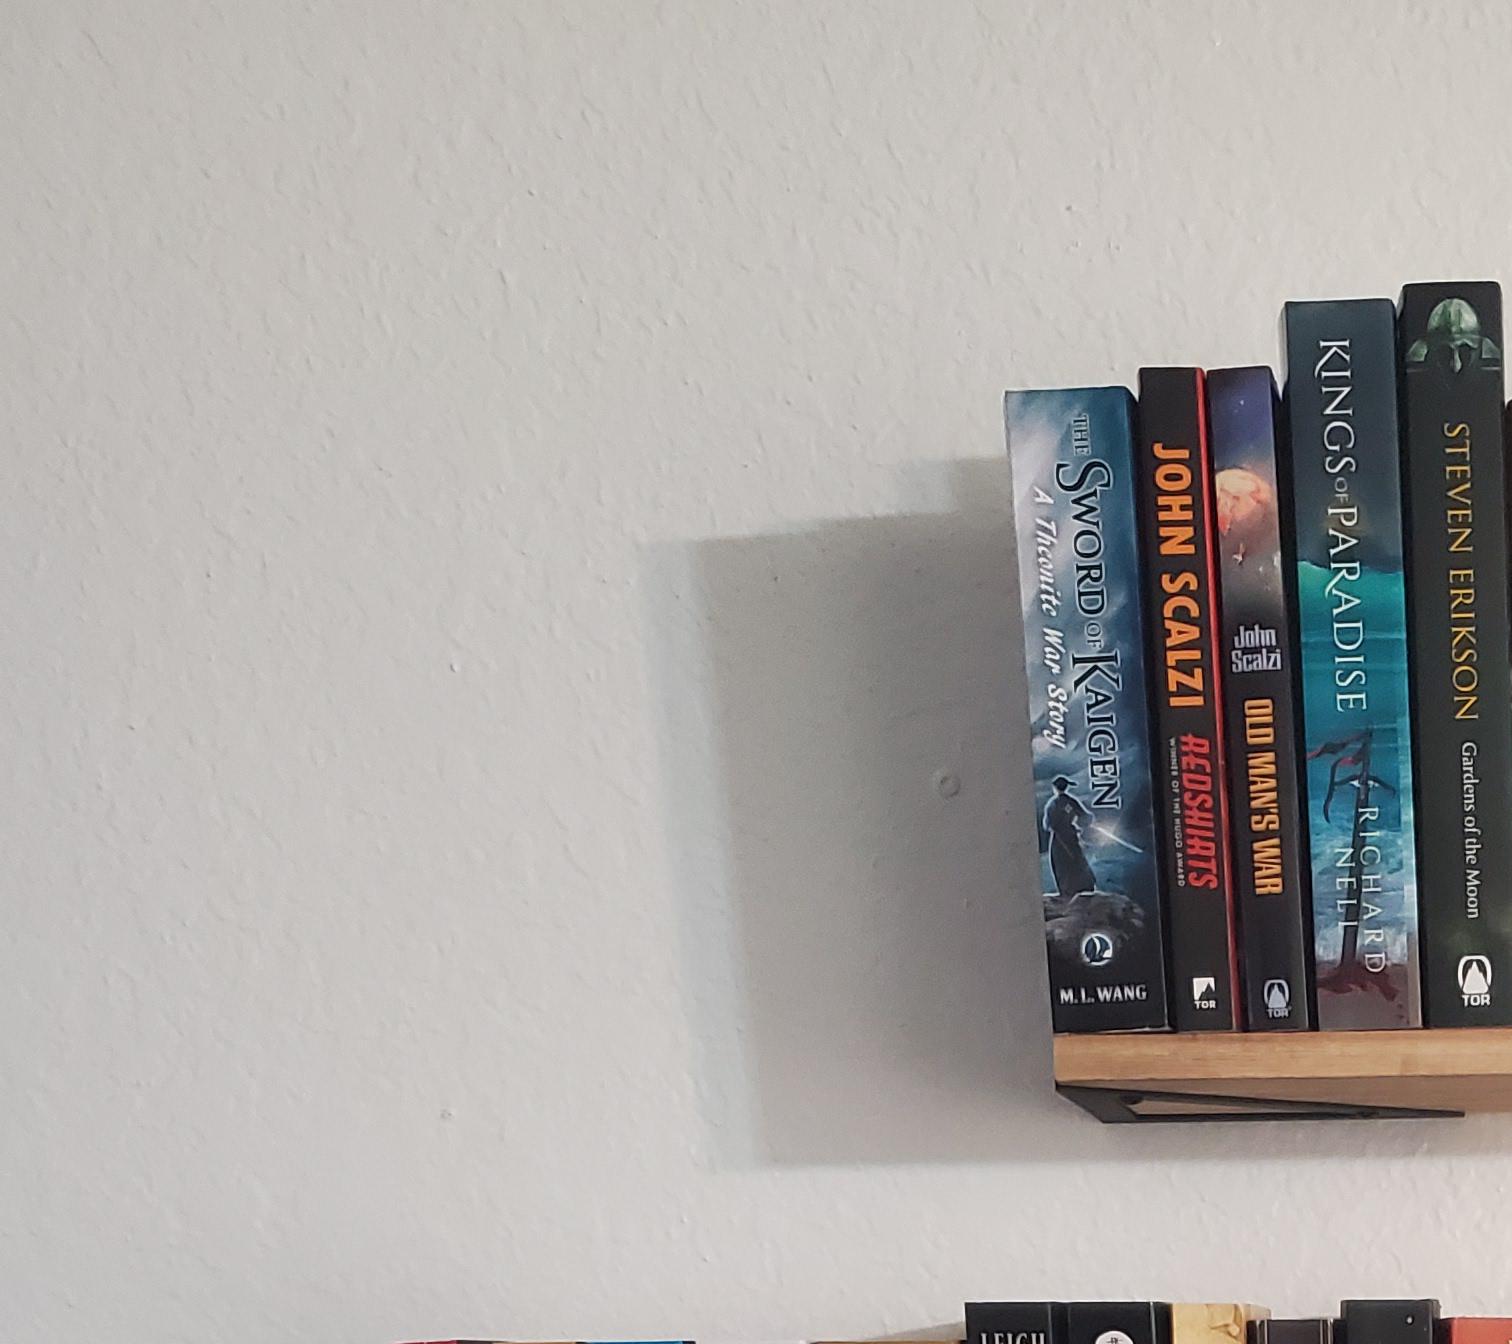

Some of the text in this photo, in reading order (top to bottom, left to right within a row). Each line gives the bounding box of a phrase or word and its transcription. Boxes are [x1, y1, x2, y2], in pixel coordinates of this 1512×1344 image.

[1032, 486, 1069, 749] A Theonite War Story
[1055, 415, 1122, 809] THE SWORD OF KAIGEN
[1313, 338, 1368, 713] KINGS OF PARADISE
[1443, 422, 1479, 721] STEVEN ERIKSON
[1153, 442, 1218, 889] JOHN SCALZI REDSHIRTS
[1231, 649, 1282, 673] Scalzi
[1234, 624, 1276, 648] John
[1244, 698, 1283, 895] OLD MAN'S WAR
[1334, 848, 1358, 929] NELL
[1461, 741, 1482, 919] Gardens of the Moon
[1358, 807, 1386, 974] RICHARD
[1461, 995, 1491, 1007] TOR
